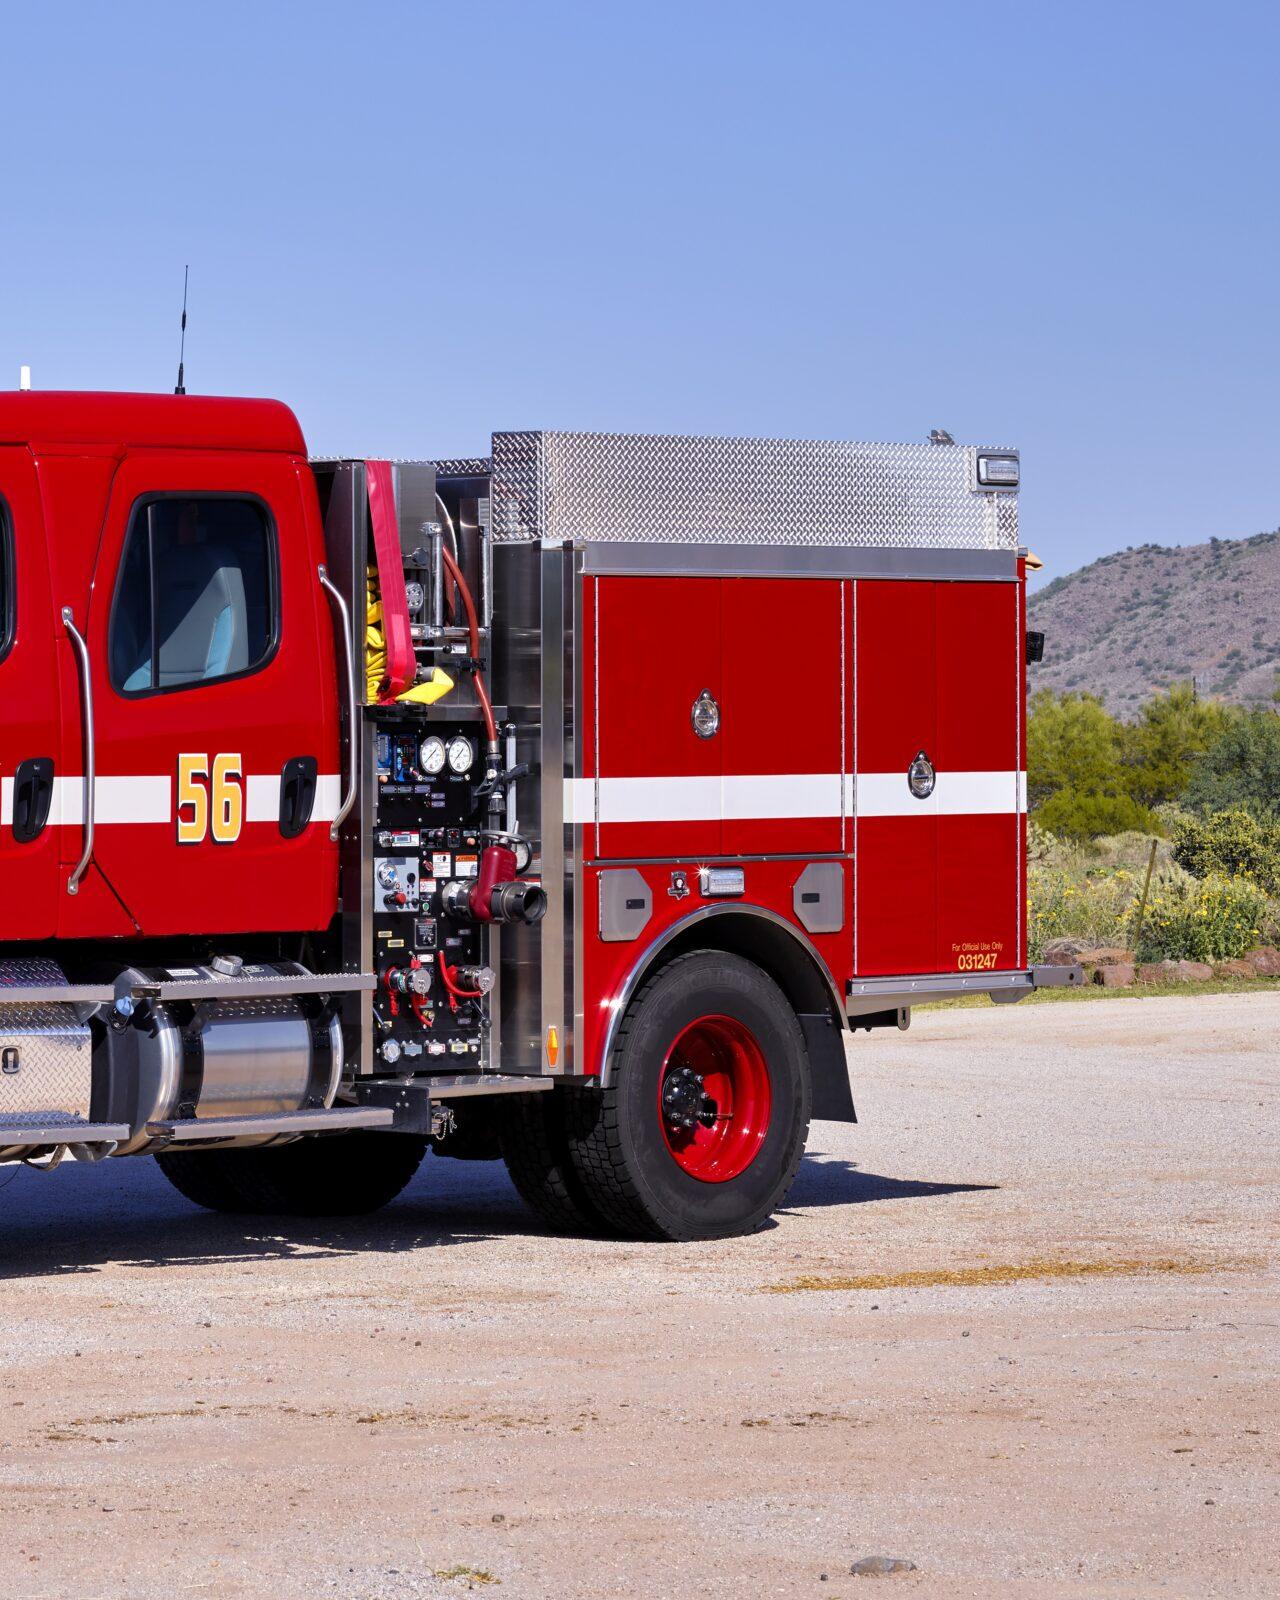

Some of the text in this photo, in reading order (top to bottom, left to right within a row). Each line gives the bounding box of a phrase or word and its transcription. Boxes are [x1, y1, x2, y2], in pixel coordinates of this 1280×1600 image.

[178, 753, 242, 844] 56
[952, 942, 1003, 952] For Official Use Only
[957, 953, 998, 970] 031247
